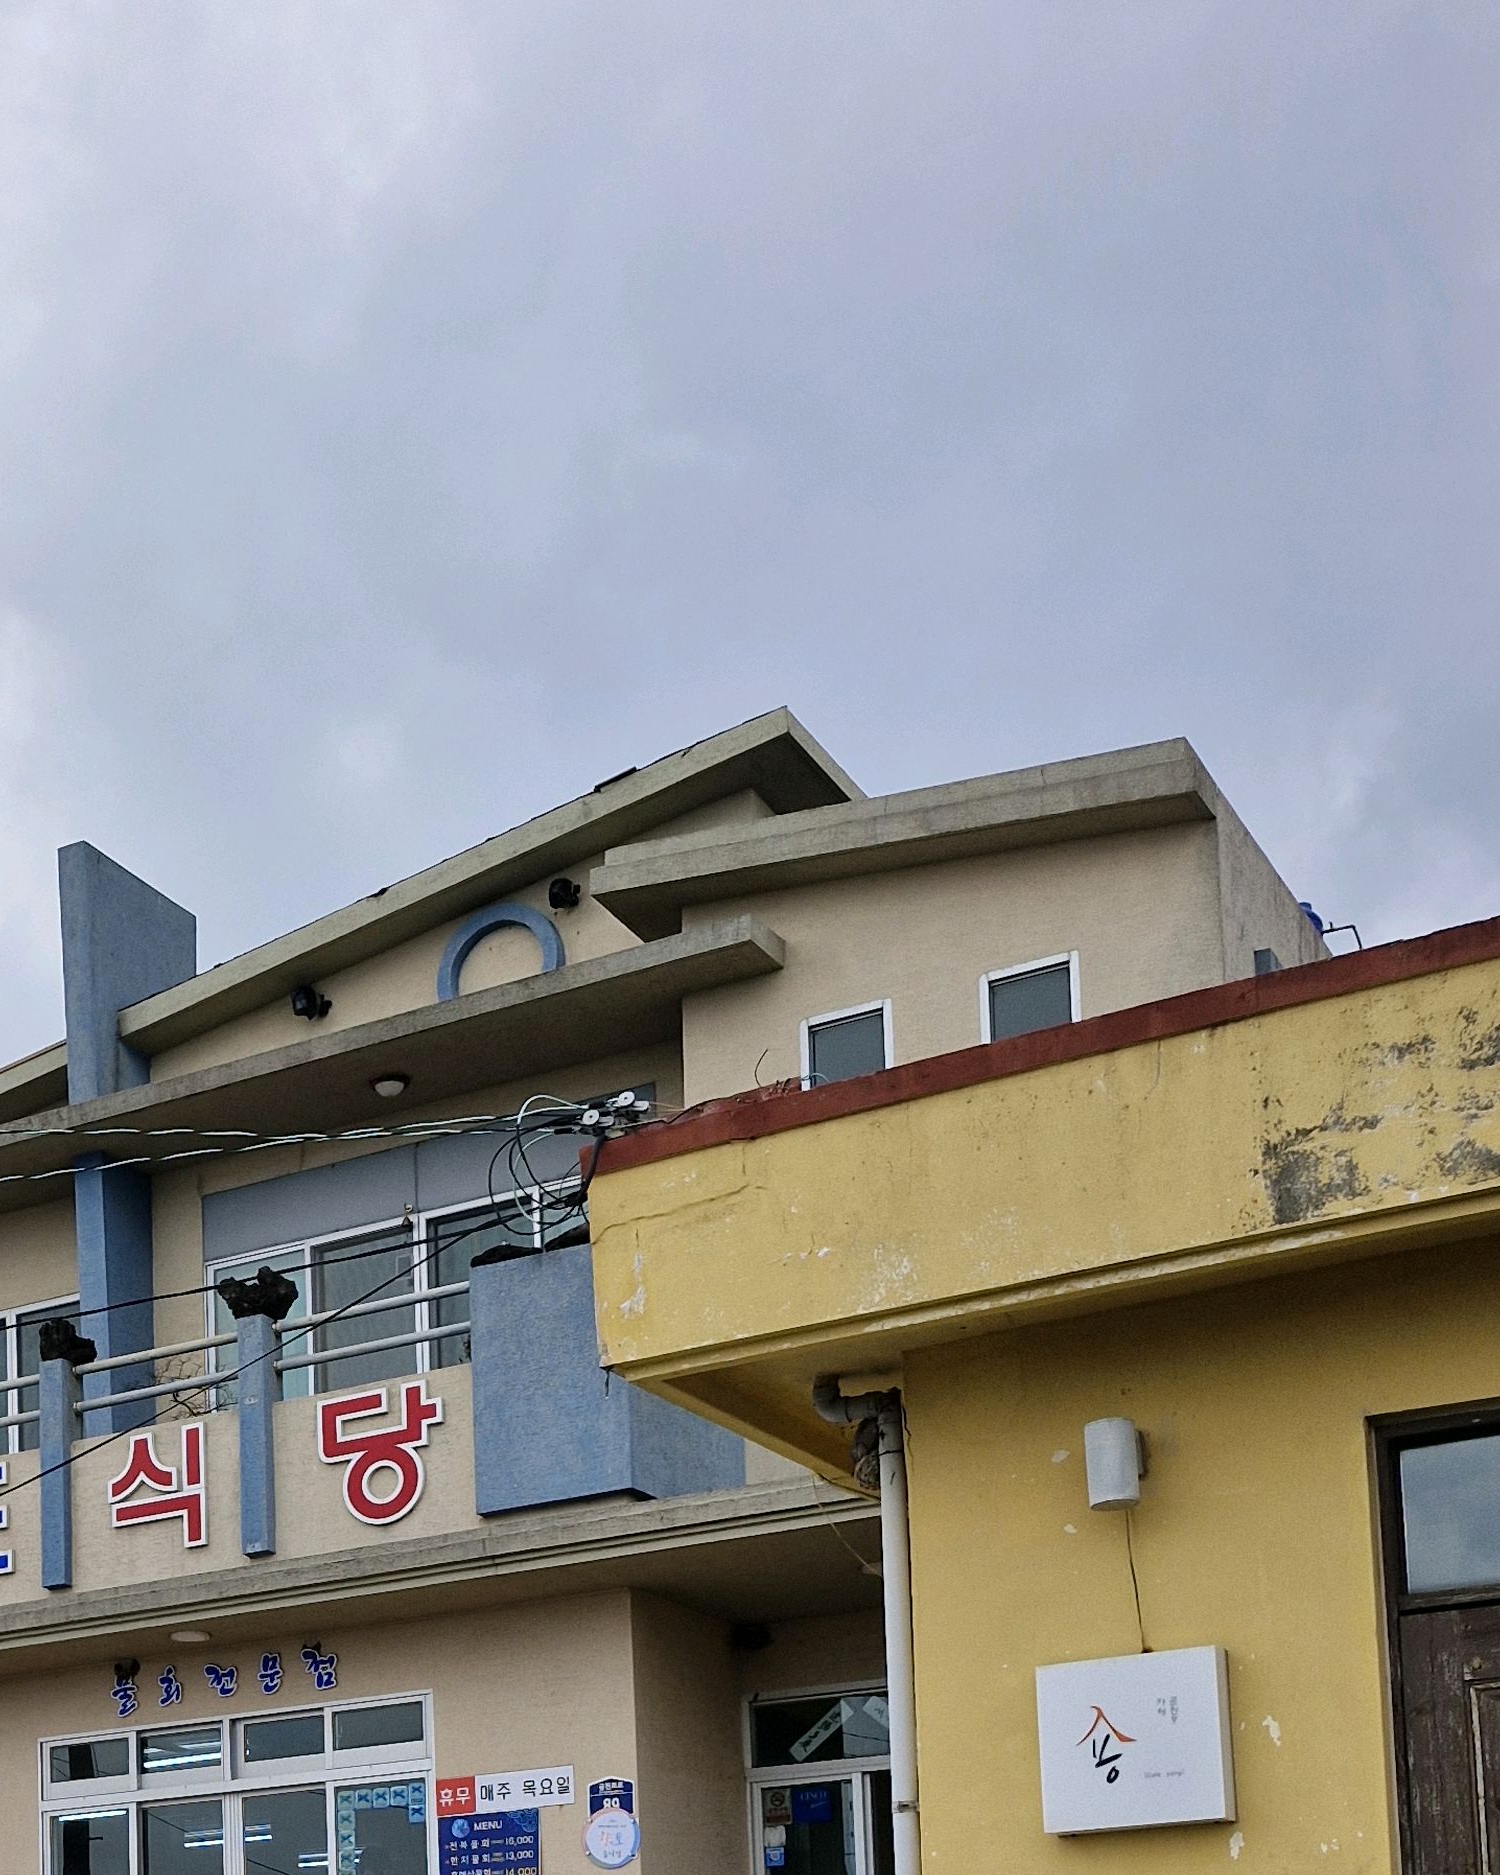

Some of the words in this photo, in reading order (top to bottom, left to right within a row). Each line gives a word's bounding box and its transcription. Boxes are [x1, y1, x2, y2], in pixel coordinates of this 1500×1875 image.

[439, 1786, 471, 1807] 휴무
[480, 1782, 511, 1801] 매주
[522, 1776, 570, 1797] 목요일
[473, 1820, 503, 1831] MENU
